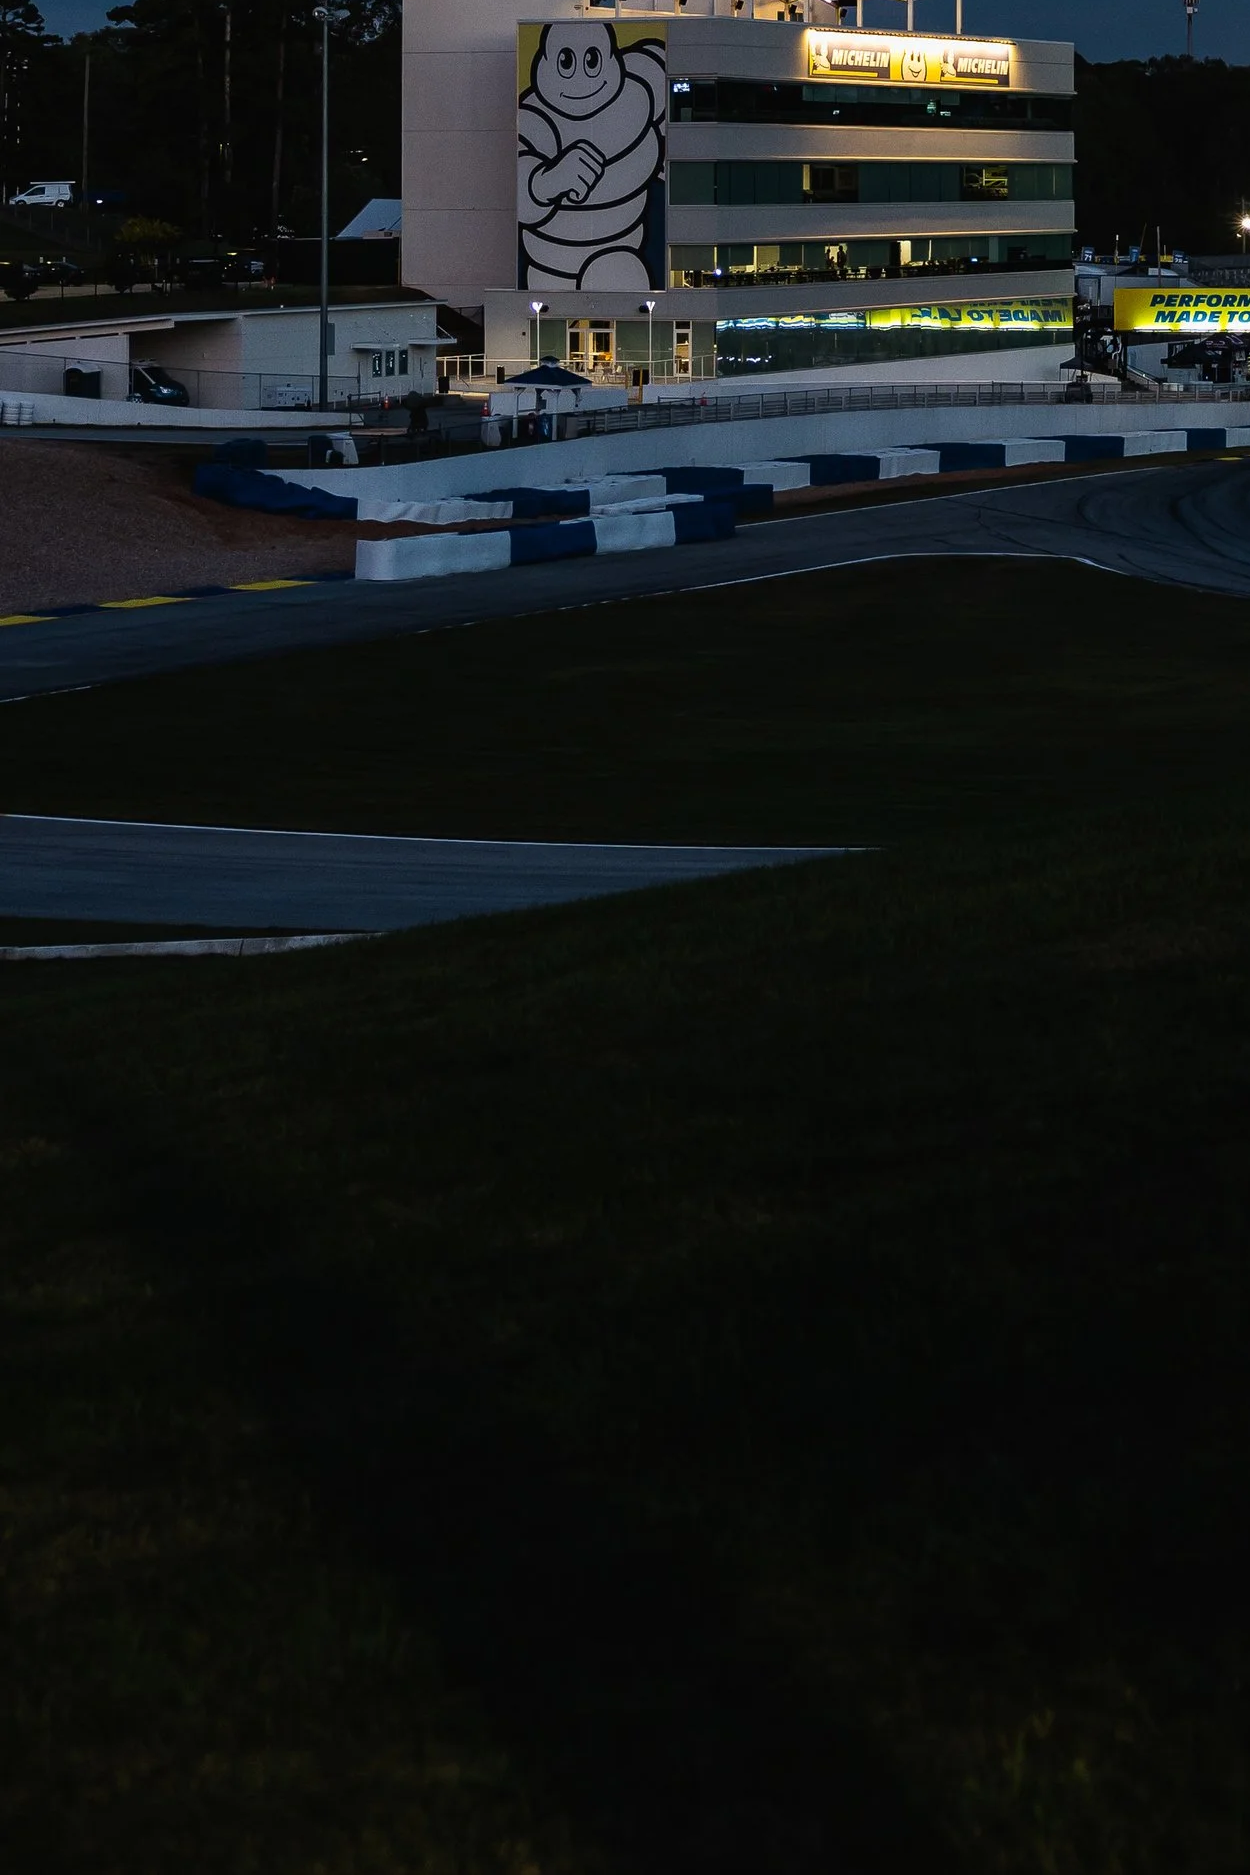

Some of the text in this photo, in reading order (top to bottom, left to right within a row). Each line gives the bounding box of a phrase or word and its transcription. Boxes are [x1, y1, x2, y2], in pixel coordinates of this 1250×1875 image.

[832, 49, 890, 68] MICHELIN
[957, 58, 1009, 75] MICHELIN
[1154, 310, 1222, 323] MADE
